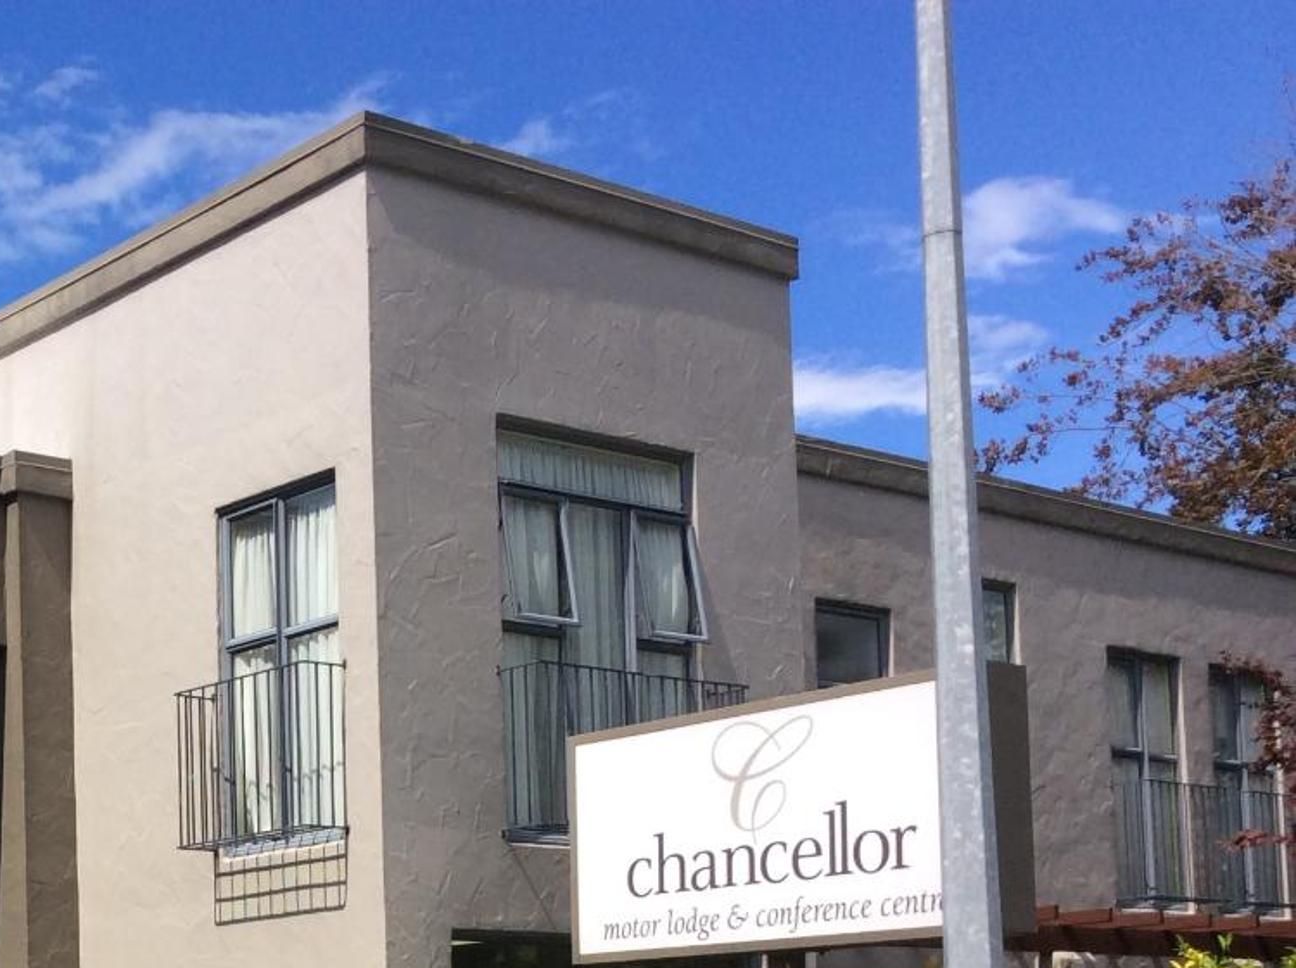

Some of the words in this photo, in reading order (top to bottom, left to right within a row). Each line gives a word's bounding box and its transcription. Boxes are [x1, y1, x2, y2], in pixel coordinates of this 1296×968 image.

[626, 800, 918, 898] chancellor
[603, 917, 661, 941] motor
[667, 907, 720, 941] lodge
[726, 903, 749, 931] &
[756, 895, 872, 934] conference
